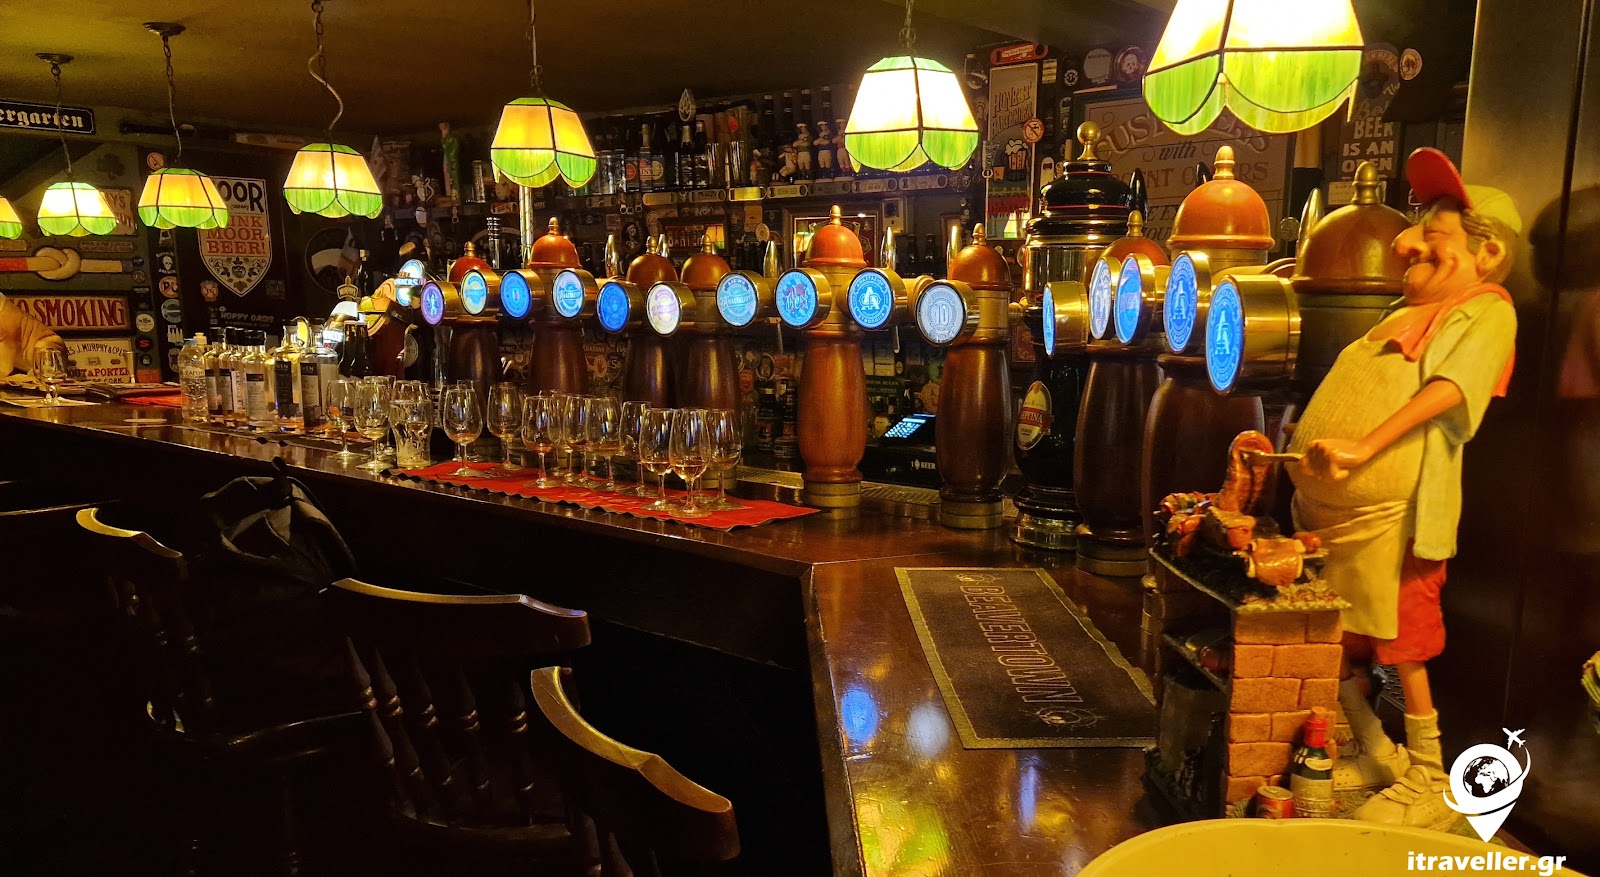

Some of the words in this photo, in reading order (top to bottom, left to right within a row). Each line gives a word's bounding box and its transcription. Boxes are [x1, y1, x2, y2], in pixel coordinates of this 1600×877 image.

[1158, 141, 1198, 161] with
[1342, 143, 1360, 157] IS
[1366, 141, 1394, 156] AN
[1341, 158, 1393, 173] ON
[217, 180, 264, 213] OOR
[230, 215, 263, 228] INK
[206, 227, 264, 241] MOOR
[206, 241, 266, 255] BEER!
[33, 298, 126, 328] SMOKING
[82, 343, 107, 353] MURPHY
[94, 367, 130, 378] PORTER
[921, 461, 937, 470] BEER
[959, 585, 1084, 703] BEAVERTOWN
